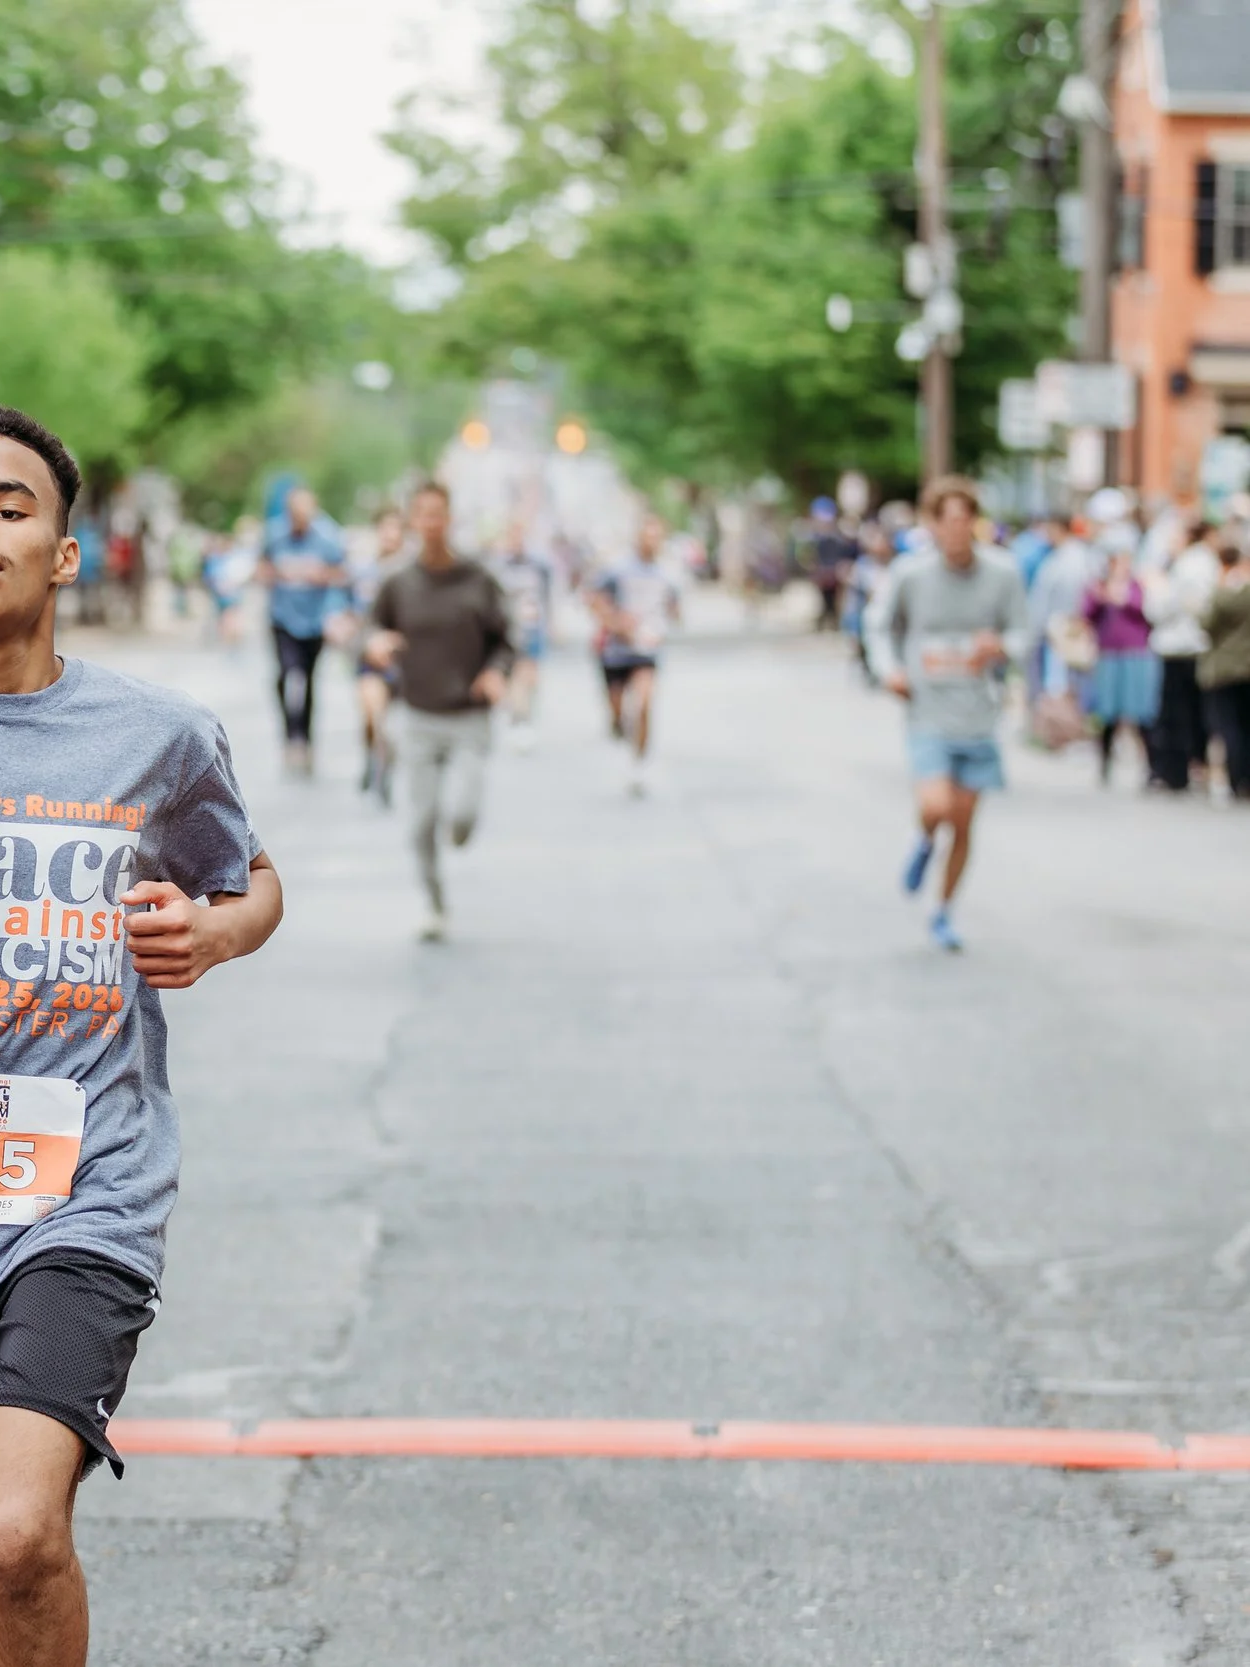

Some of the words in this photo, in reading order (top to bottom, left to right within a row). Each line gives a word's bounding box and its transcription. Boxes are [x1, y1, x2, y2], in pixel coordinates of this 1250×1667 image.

[25, 795, 146, 830] Running!
[52, 982, 124, 1012] 2026
[85, 1014, 121, 1039] PA
